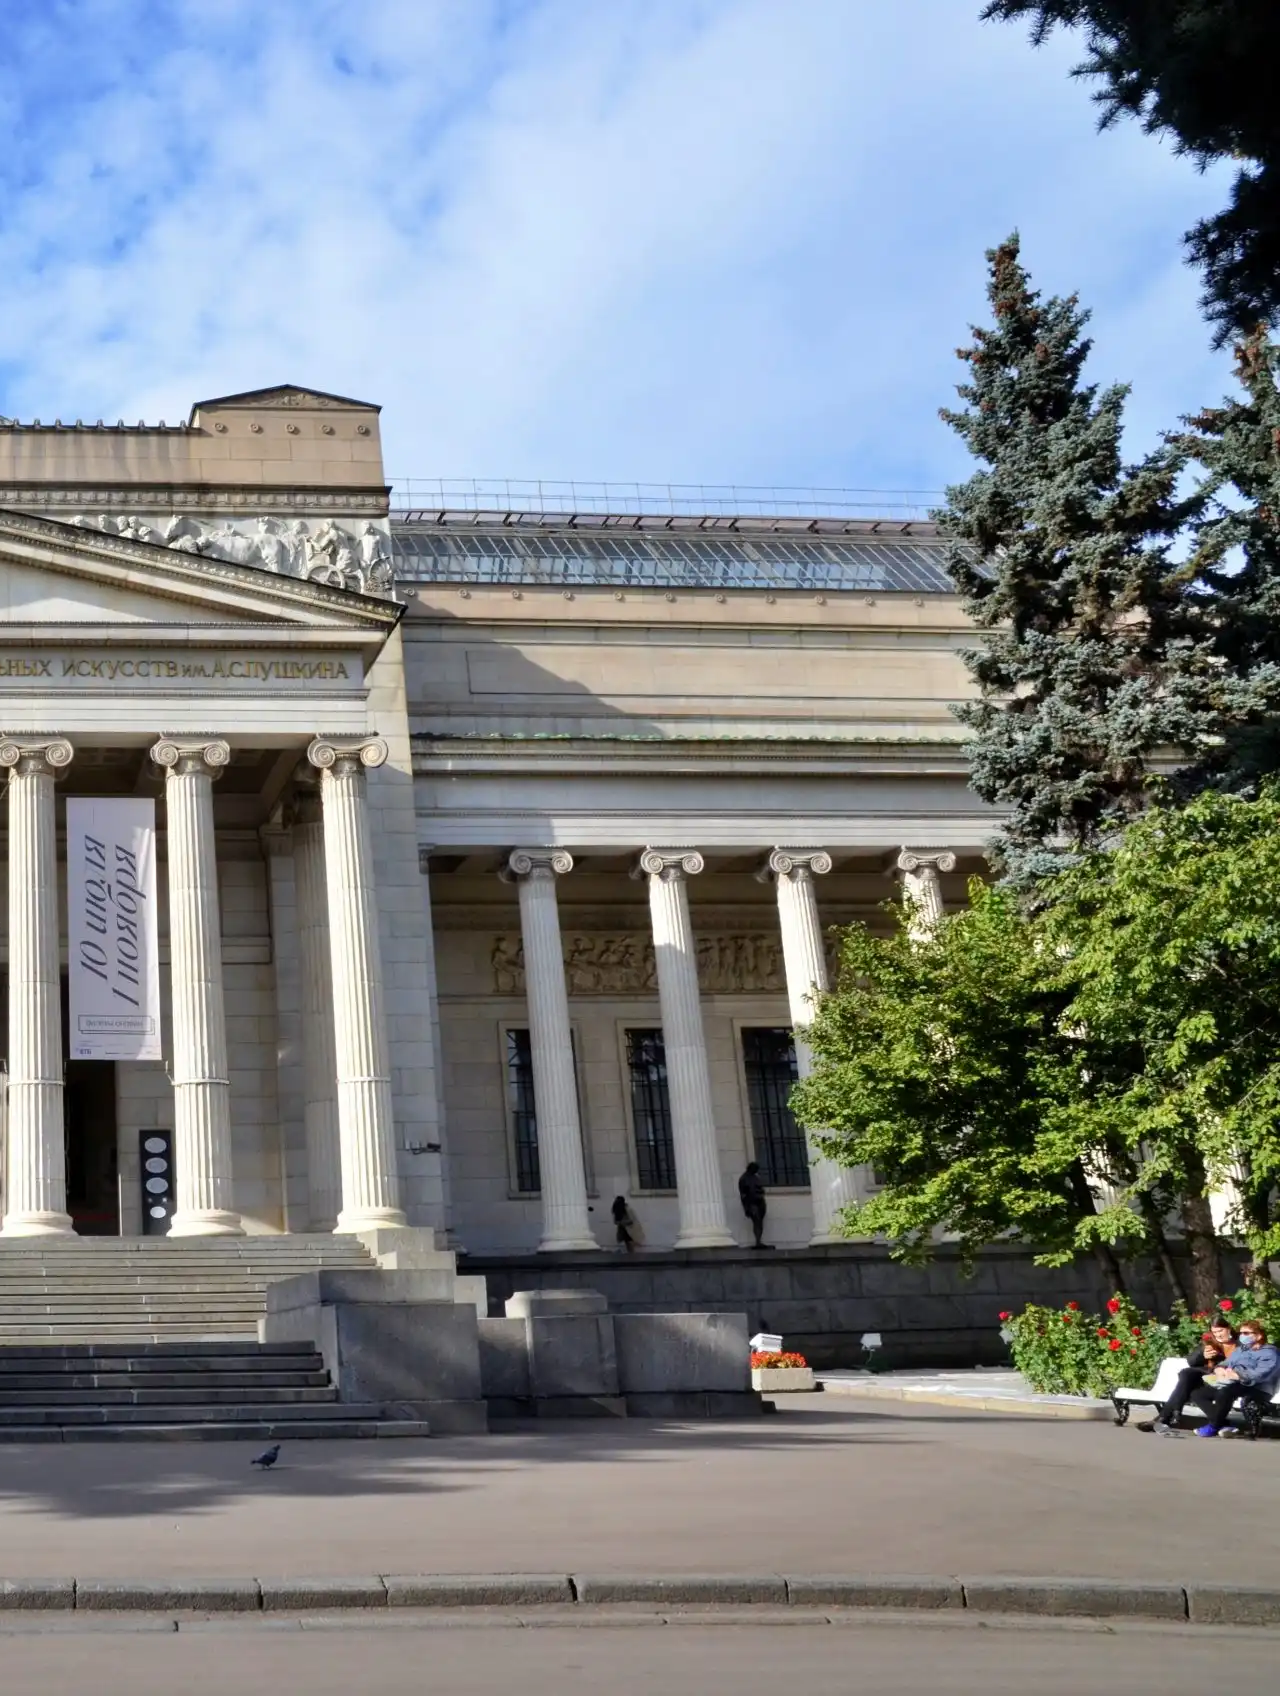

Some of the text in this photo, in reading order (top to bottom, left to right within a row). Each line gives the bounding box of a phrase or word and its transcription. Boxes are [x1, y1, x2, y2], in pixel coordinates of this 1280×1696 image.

[62, 659, 177, 680] ИСКУССТВ
[80, 940, 108, 980] 10
[112, 987, 140, 1006] 1
